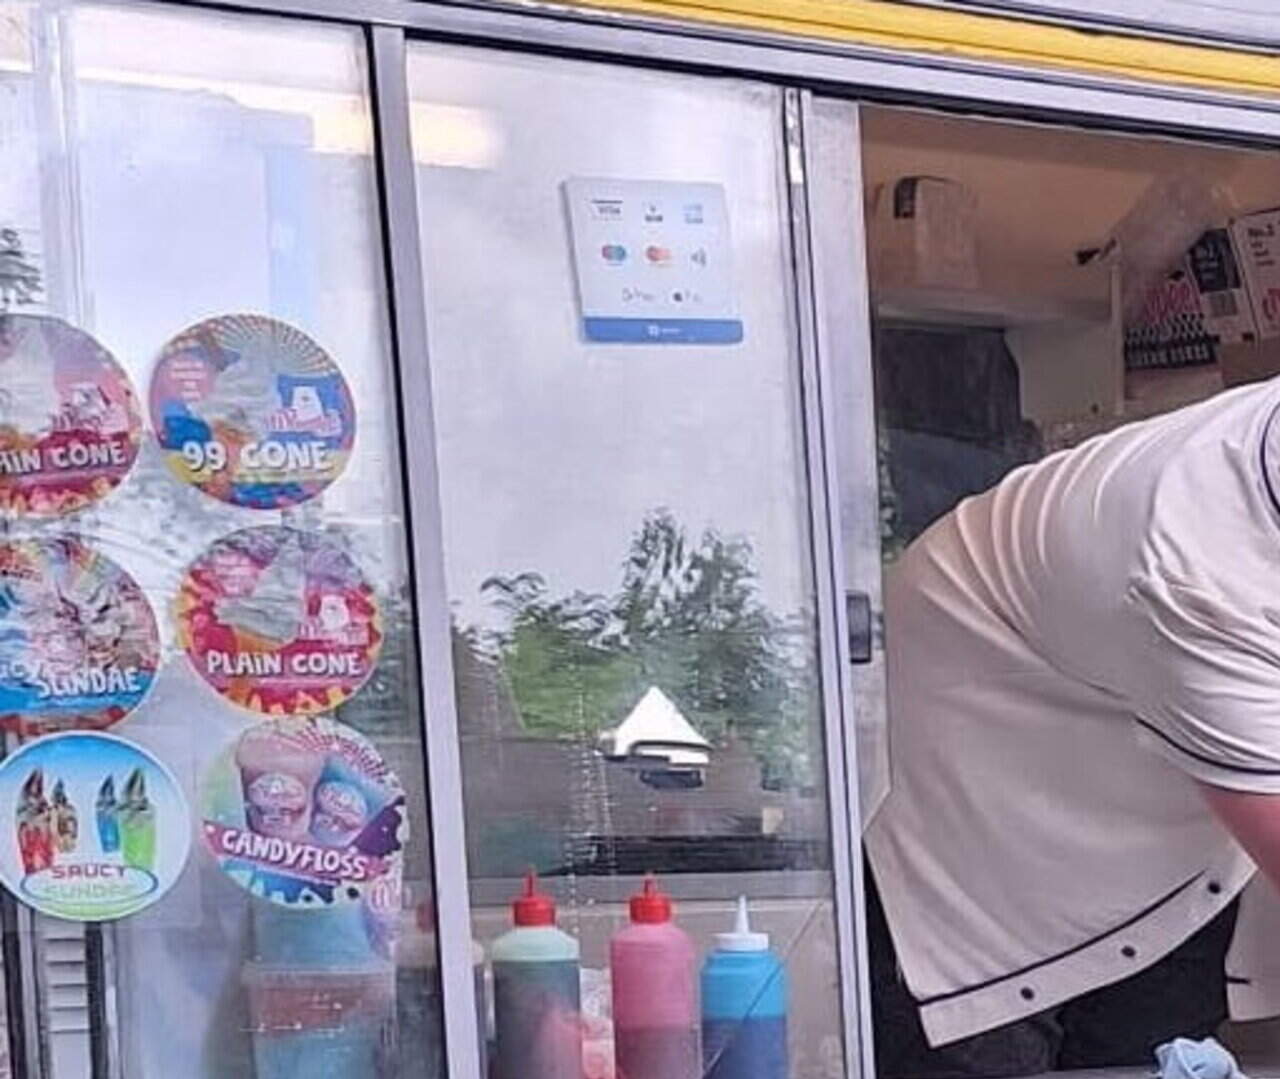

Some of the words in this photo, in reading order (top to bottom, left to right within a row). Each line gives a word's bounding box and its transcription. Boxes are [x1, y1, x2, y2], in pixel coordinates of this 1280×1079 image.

[52, 441, 127, 466] CONE
[181, 439, 228, 472] 99
[240, 440, 335, 471] CONE
[207, 649, 283, 675] PLAIN
[291, 651, 363, 676] CONE
[222, 830, 368, 879] CANDYFLOSS
[51, 863, 127, 879] SAUCY
